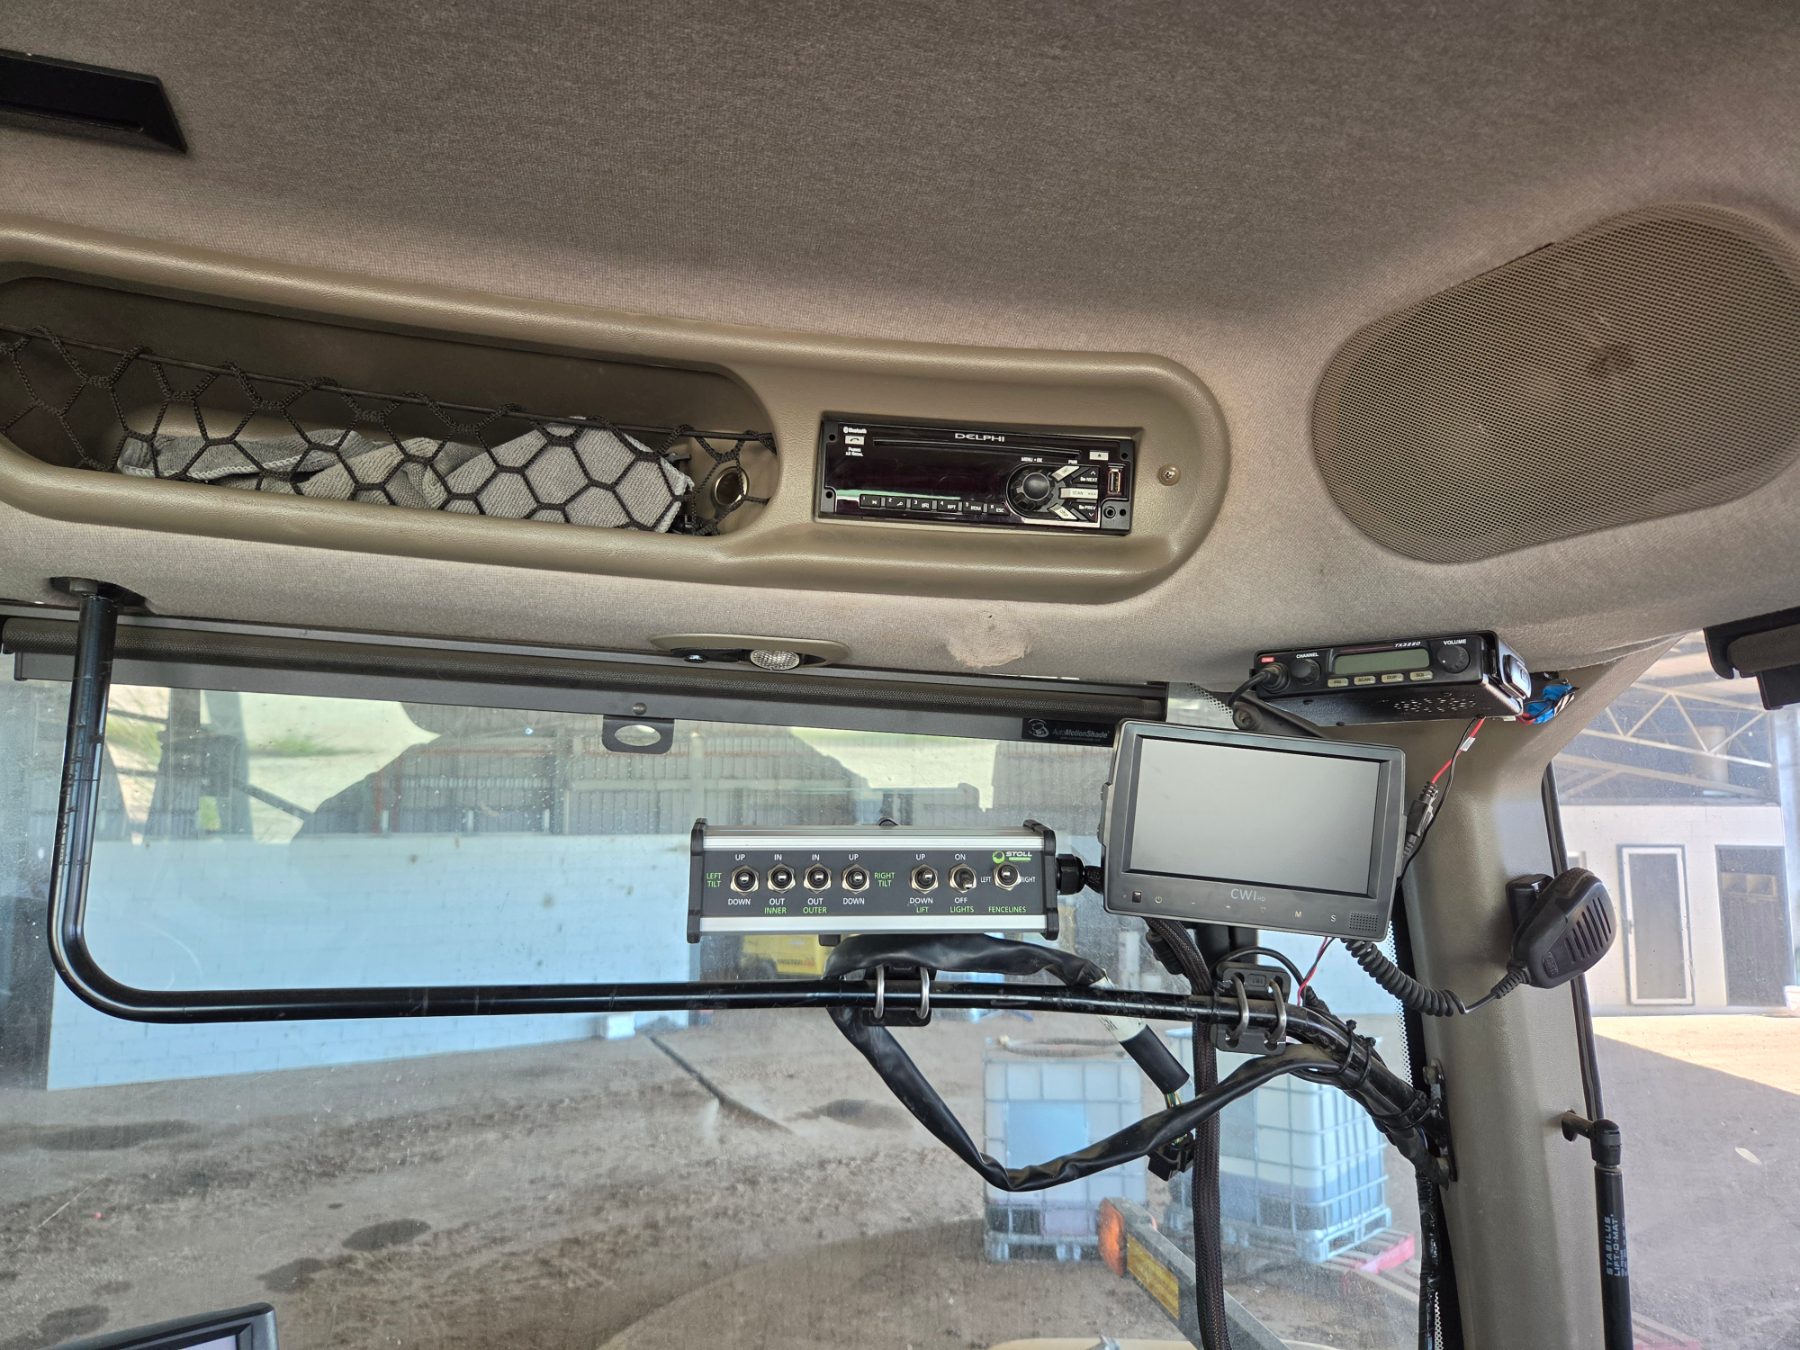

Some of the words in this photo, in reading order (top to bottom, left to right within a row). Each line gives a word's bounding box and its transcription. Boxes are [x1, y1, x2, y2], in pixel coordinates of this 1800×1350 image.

[954, 432, 1005, 442] DELPHI
[1443, 638, 1467, 646] VOLUME
[915, 853, 926, 861] UP
[706, 872, 722, 880] LEFT
[874, 872, 896, 880] RIGHT
[707, 880, 722, 888] TILT
[878, 879, 892, 887] TILT
[728, 898, 751, 906] DOWN
[769, 898, 785, 906] OUT
[807, 898, 824, 906] OUT
[842, 897, 865, 905] DOWN
[764, 907, 787, 915] INNER
[803, 906, 827, 914] OUTER
[1294, 910, 1302, 918] M
[1330, 914, 1337, 922] S
[1604, 1216, 1614, 1275] STABILUS
